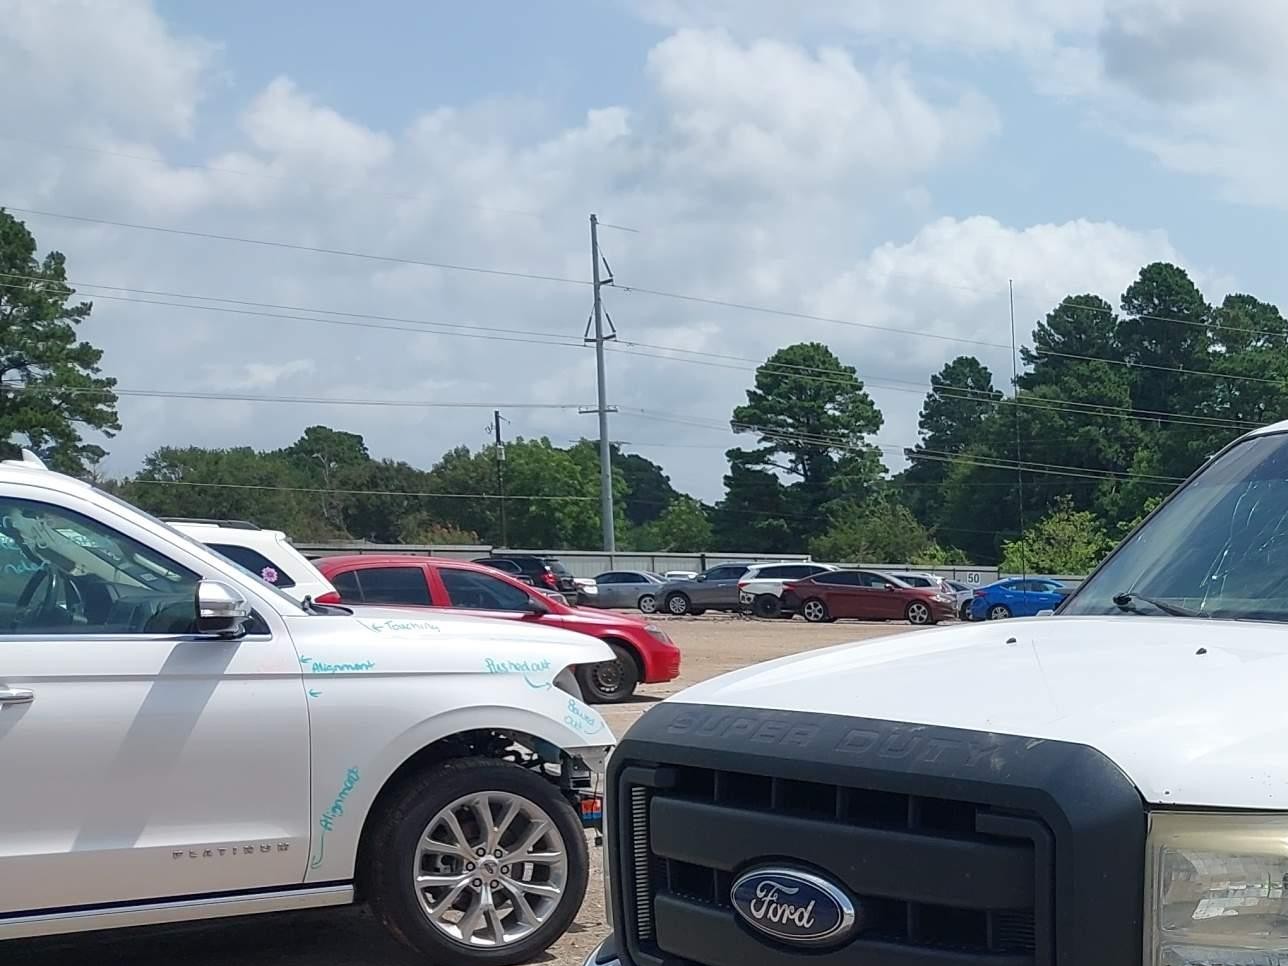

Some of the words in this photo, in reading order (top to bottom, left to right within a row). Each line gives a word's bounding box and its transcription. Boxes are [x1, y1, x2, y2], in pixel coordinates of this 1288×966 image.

[968, 573, 980, 584] 50
[312, 660, 376, 675] Alignment
[666, 711, 822, 748] SUPER
[833, 727, 1002, 768] DUTY
[172, 843, 290, 859] PLATINUM
[750, 880, 816, 928] Ford
